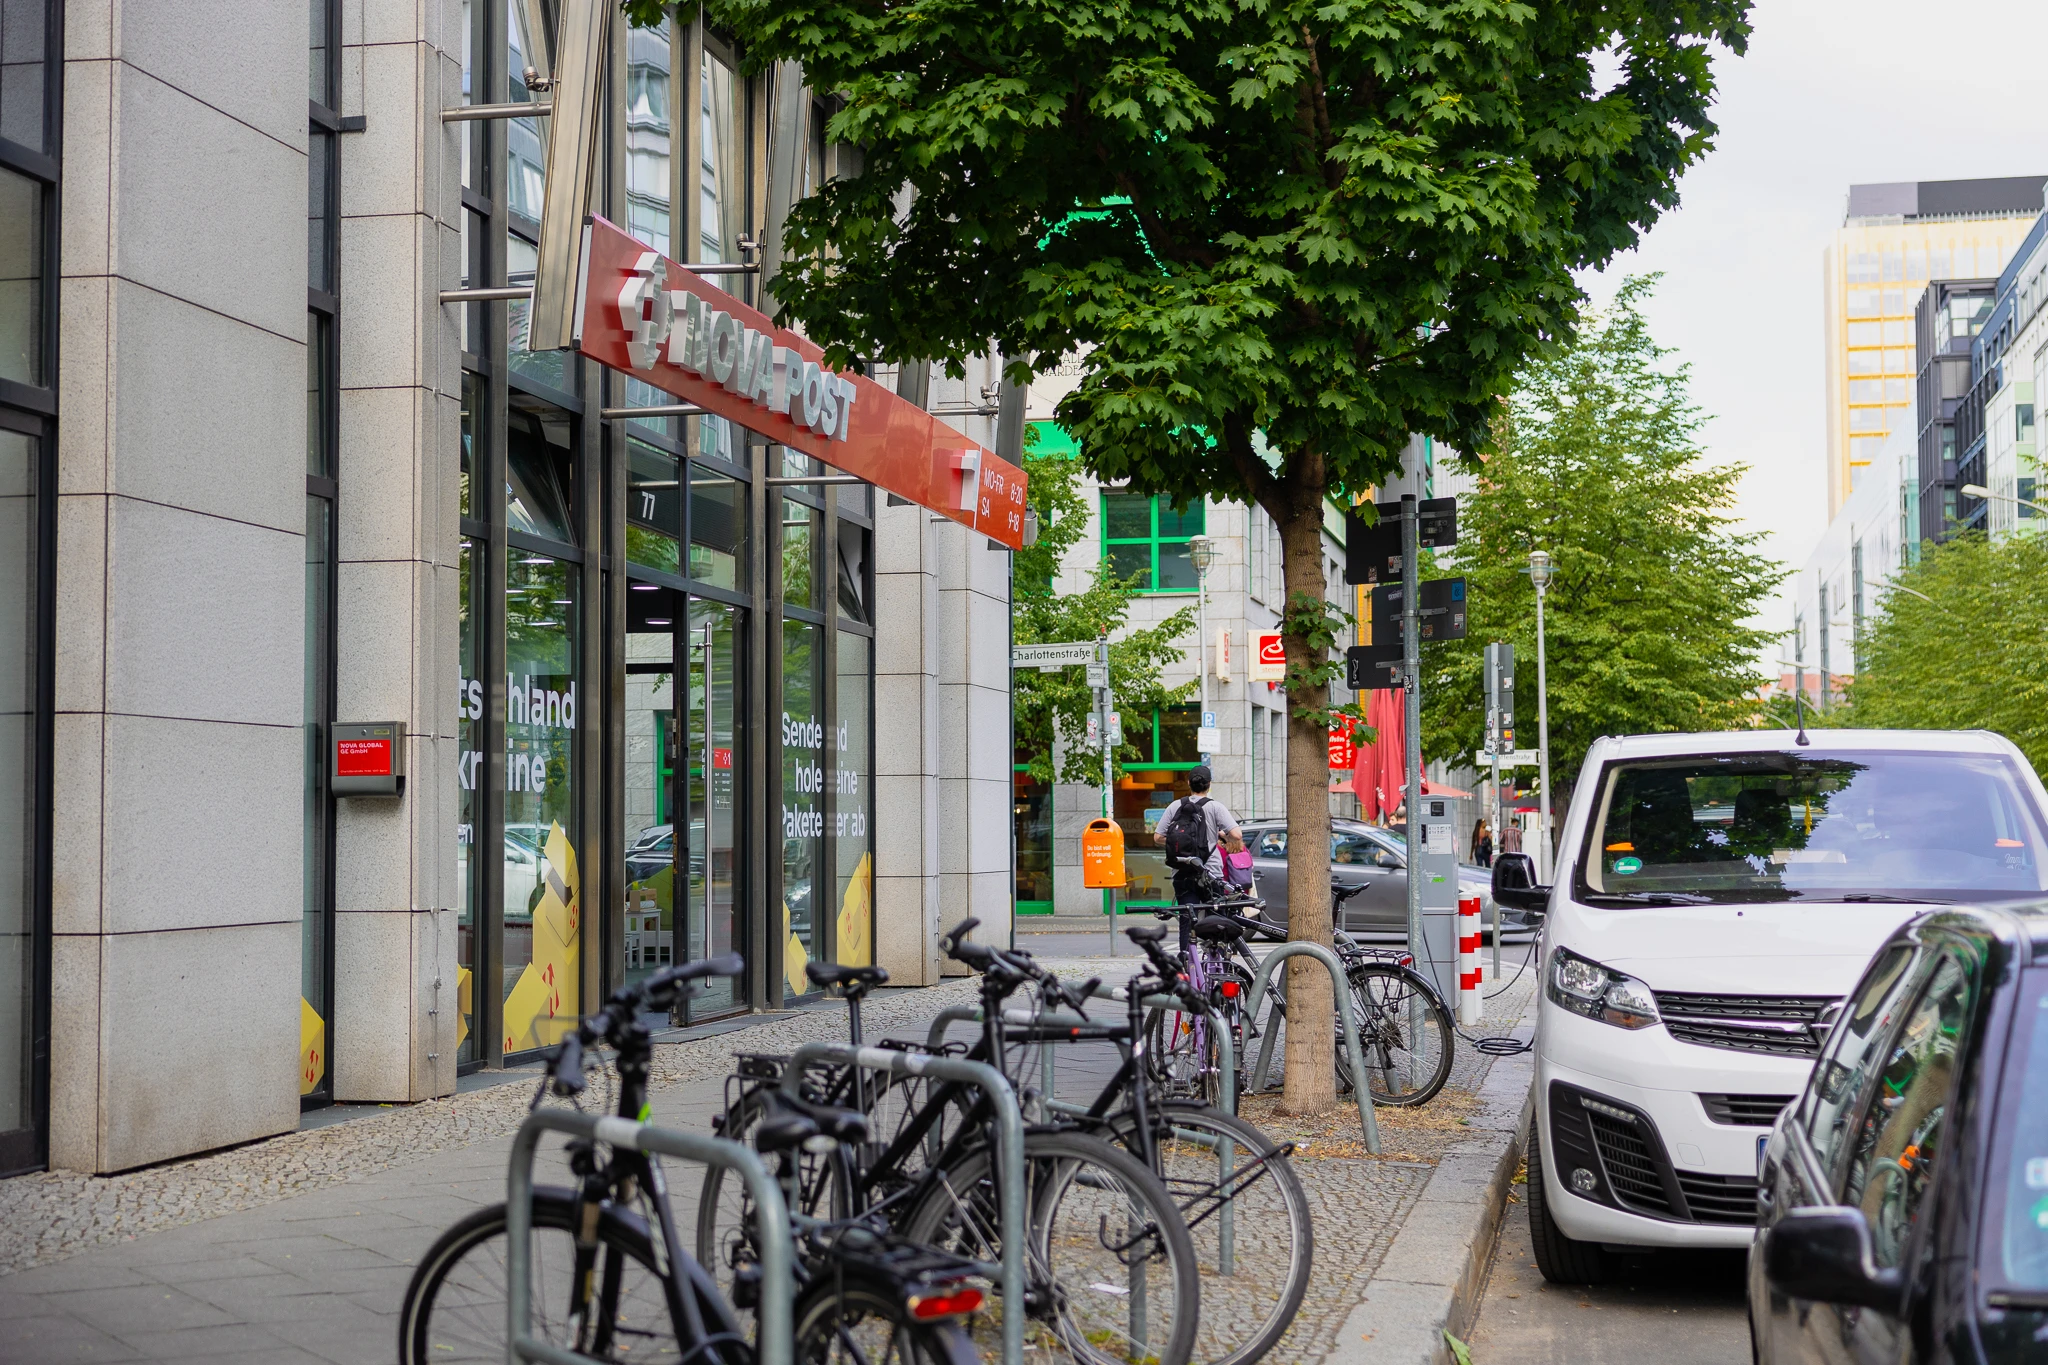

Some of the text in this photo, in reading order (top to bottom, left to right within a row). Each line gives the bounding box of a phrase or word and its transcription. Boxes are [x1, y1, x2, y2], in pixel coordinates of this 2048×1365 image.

[668, 290, 857, 442] NOVA POST
[1063, 352, 1084, 363] ALL
[984, 467, 1023, 505] MO-FR 8-20
[642, 491, 655, 520] 77
[981, 497, 1020, 532] SA 9-18
[1013, 648, 1091, 660] Charlottenstraße
[782, 712, 822, 749] Sende
[795, 758, 858, 795] hole eine
[837, 812, 849, 837] er
[851, 805, 865, 837] ab
